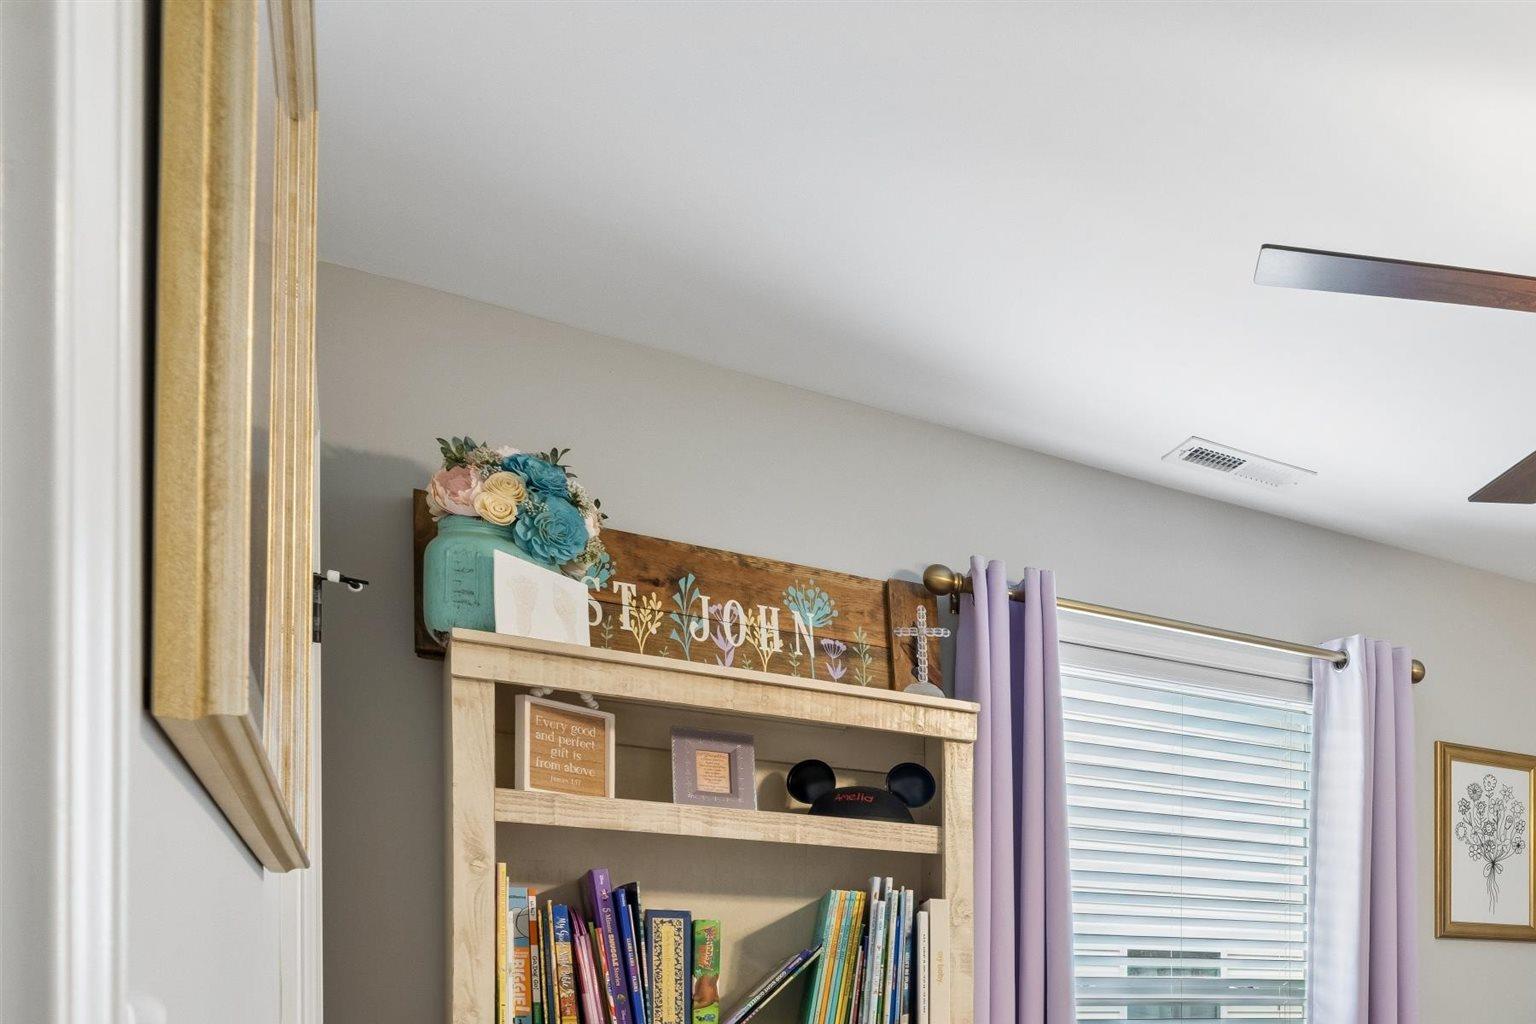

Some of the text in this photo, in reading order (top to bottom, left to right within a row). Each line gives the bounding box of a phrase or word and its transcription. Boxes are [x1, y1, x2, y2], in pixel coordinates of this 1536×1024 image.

[689, 595, 815, 658] JOHN
[535, 715, 596, 738] Every good
[535, 731, 596, 750] and perfect
[550, 747, 582, 760] gift is
[535, 757, 596, 776] from above
[835, 792, 874, 803] Amelia
[555, 917, 566, 928] My
[607, 933, 618, 966] SNUGGLE
[613, 967, 621, 986] Stories
